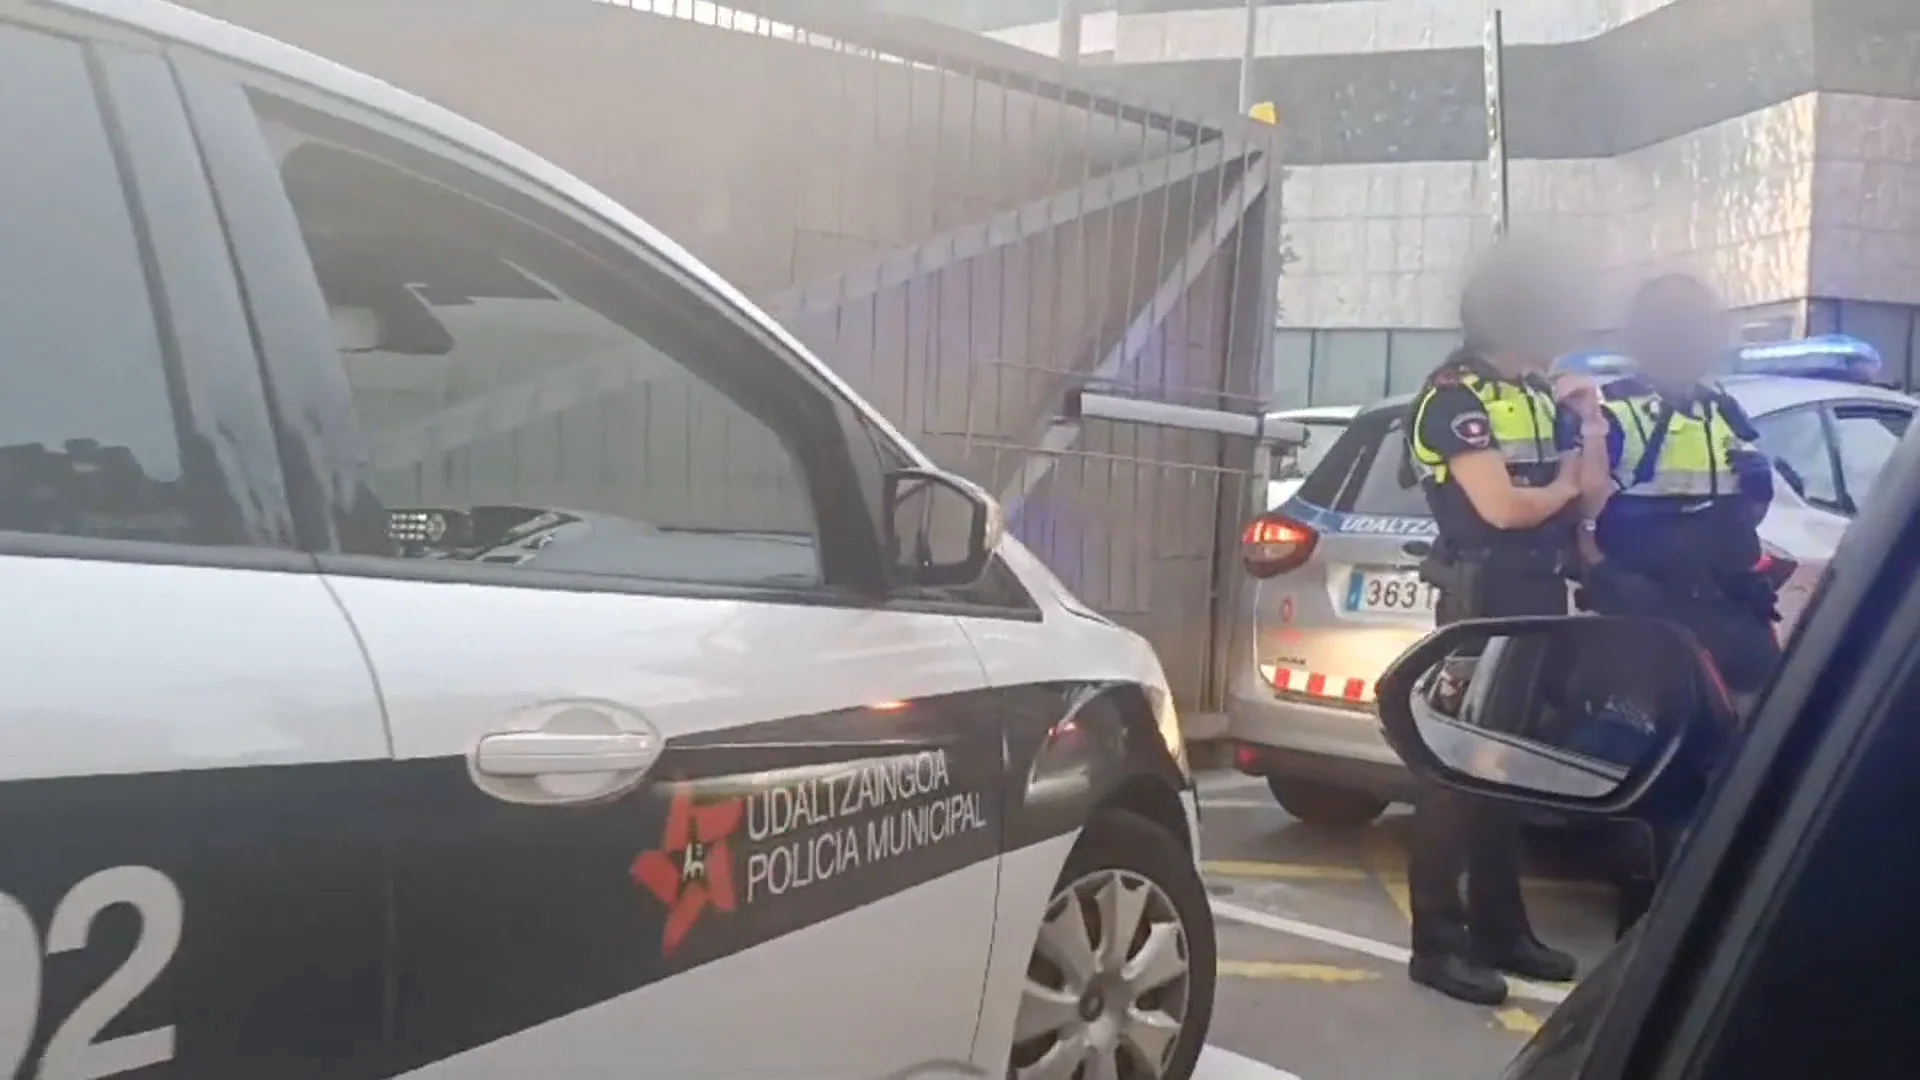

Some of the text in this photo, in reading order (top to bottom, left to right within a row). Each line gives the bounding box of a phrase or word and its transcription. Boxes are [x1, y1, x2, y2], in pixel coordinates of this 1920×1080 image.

[746, 748, 949, 841] UDALTZAINGOA
[746, 793, 987, 903] POLICIA MUNICIPAL
